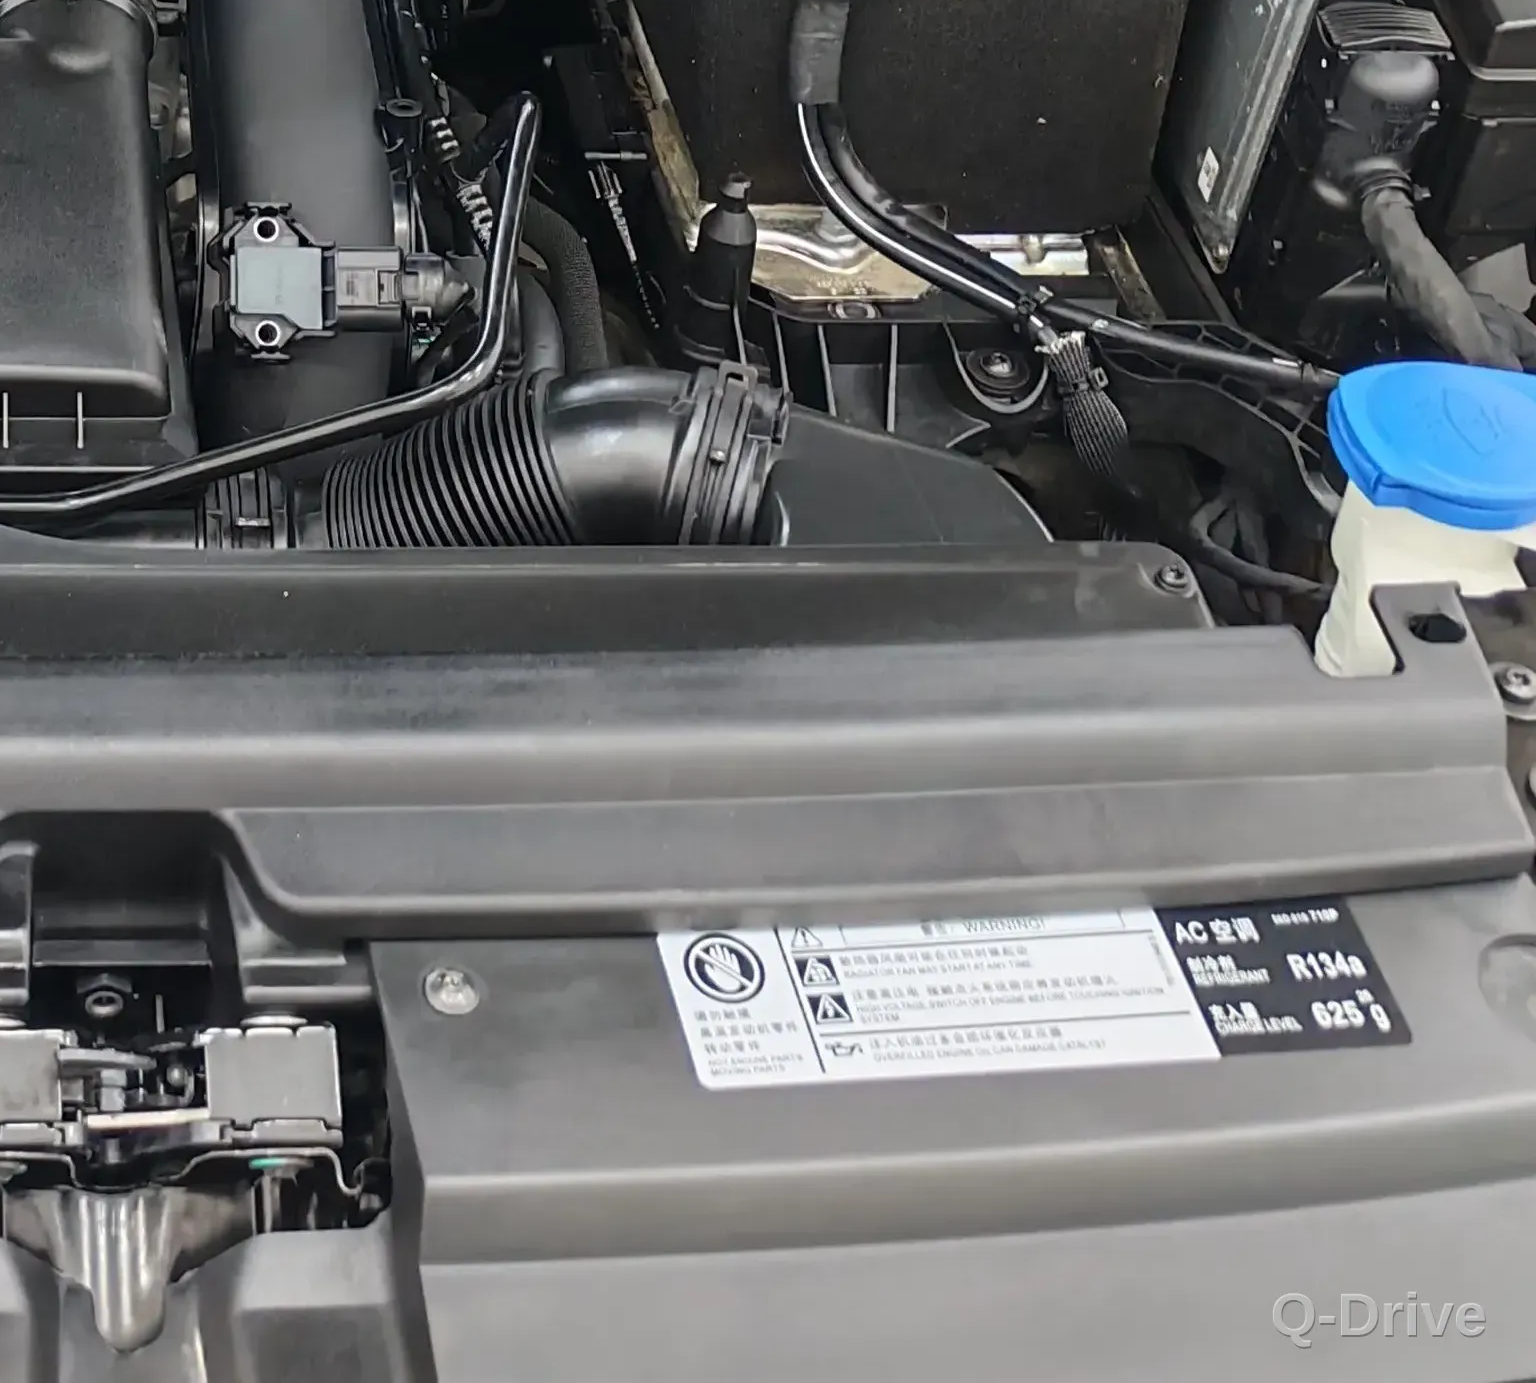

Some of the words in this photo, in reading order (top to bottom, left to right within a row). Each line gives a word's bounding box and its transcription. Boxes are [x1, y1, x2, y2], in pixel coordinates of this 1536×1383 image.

[965, 917, 1045, 933] WARNING!
[1175, 920, 1208, 945] AC
[1209, 917, 1260, 944] 空调
[1285, 950, 1368, 982] R134a
[1311, 999, 1365, 1030] 625
